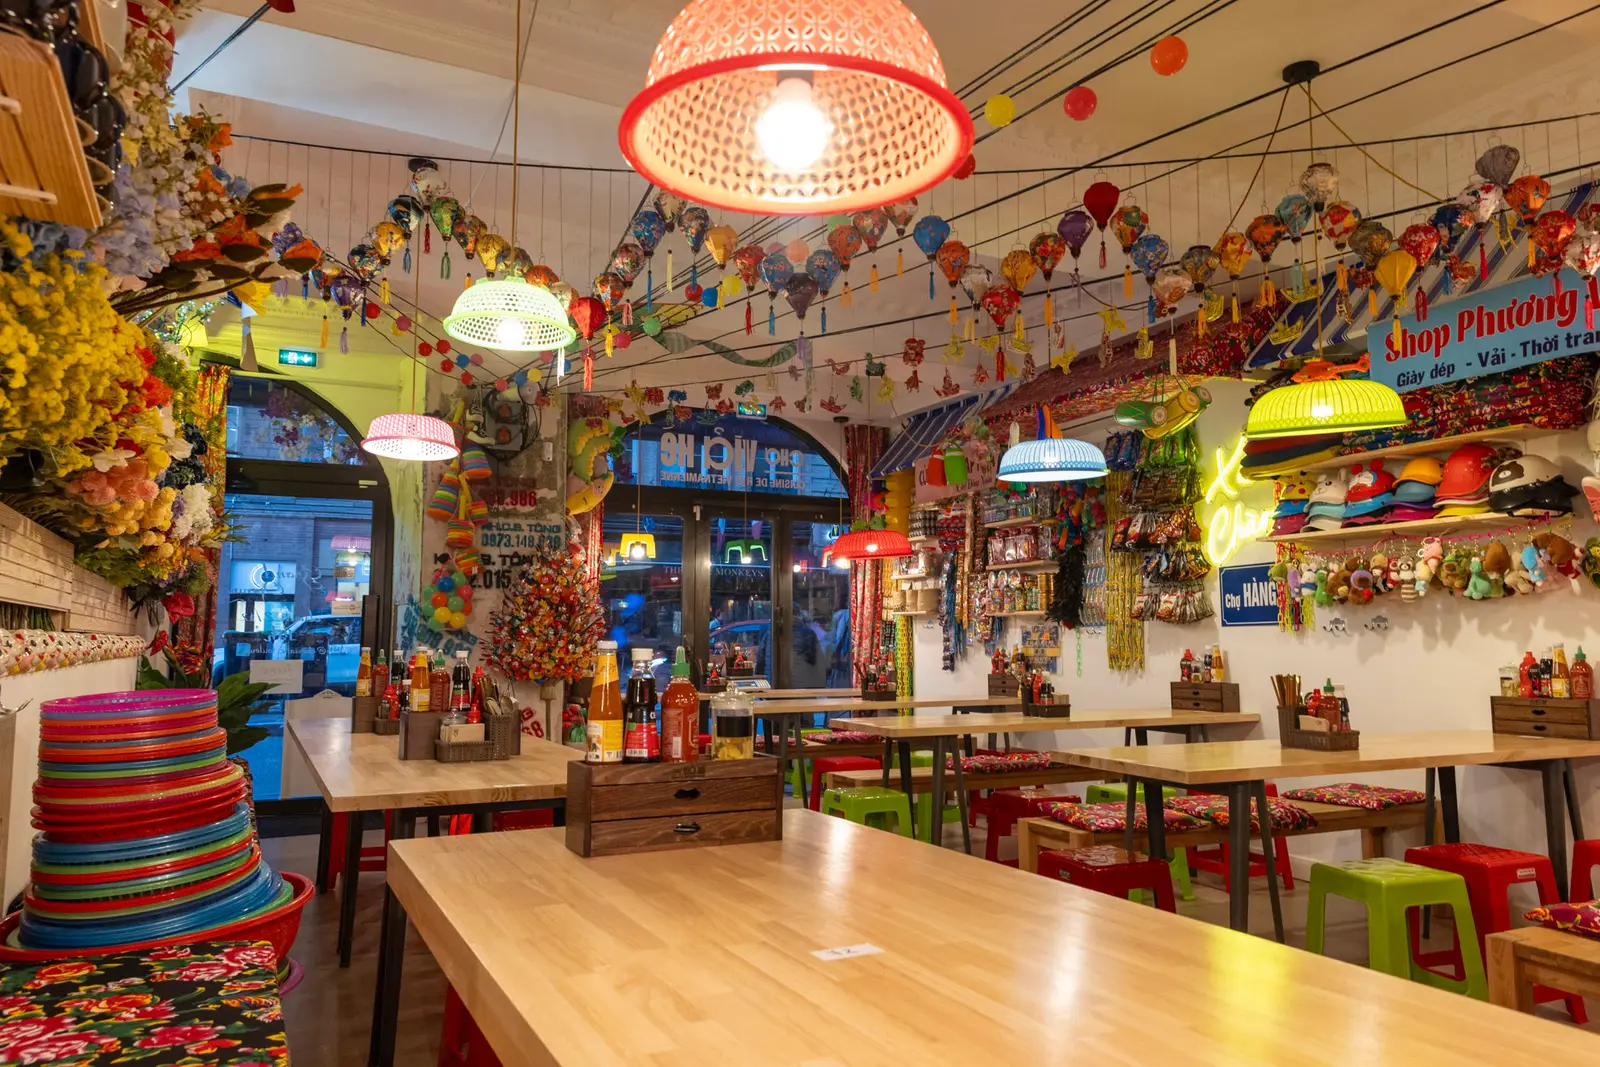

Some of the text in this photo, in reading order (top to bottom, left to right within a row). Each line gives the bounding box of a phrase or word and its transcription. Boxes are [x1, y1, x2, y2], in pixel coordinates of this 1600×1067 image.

[1384, 323, 1451, 363] Shop
[1457, 289, 1578, 343] Phương
[1396, 370, 1425, 387] Giày
[1430, 361, 1455, 379] dép
[1478, 348, 1506, 368] Vải
[1520, 335, 1559, 357] Thời
[1225, 576, 1277, 611] Chợ HÀNG
